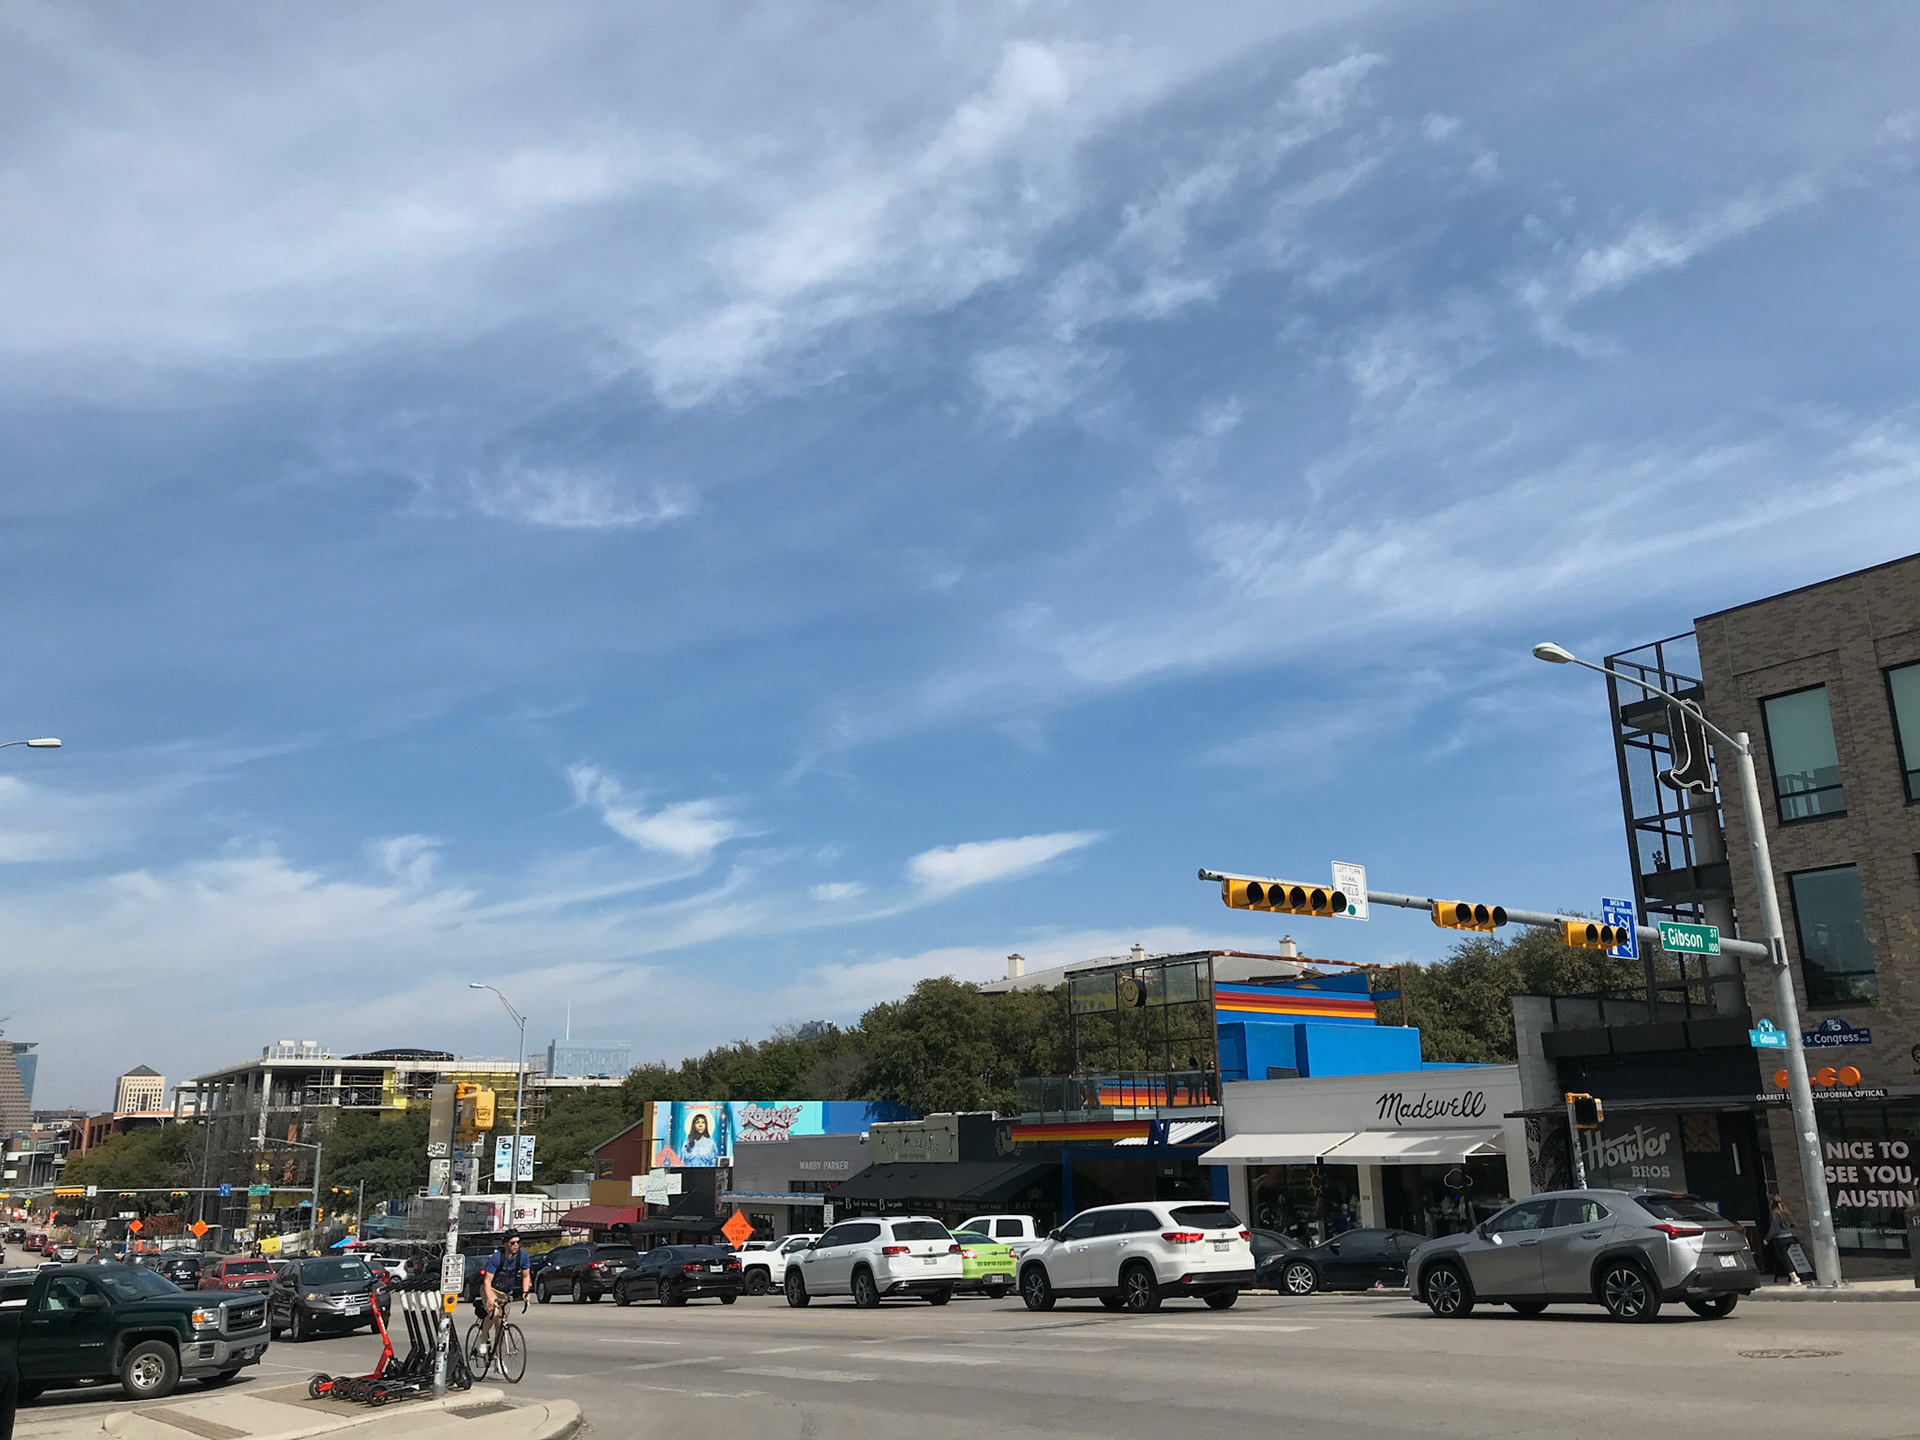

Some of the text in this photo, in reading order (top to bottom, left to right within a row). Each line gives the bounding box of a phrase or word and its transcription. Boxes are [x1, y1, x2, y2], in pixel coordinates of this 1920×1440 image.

[1661, 927, 1717, 948] E Gibson ST
[1708, 943, 1718, 952] 100
[1806, 1035, 1811, 1043] S
[1814, 1033, 1859, 1045] Congress
[1756, 1093, 1785, 1101] GARRETT
[1811, 1091, 1852, 1099] CALIFORNIA
[1854, 1089, 1885, 1098] OPTICAL
[1376, 1091, 1486, 1126] Madewell
[1581, 1125, 1670, 1170] Howler
[1825, 1141, 1910, 1159] NICE TO
[799, 1161, 849, 1170] WARBY PARKER
[1631, 1165, 1670, 1178] BROS
[1825, 1165, 1919, 1186] SEE YOU,
[1836, 1190, 1915, 1208] AUSTIN
